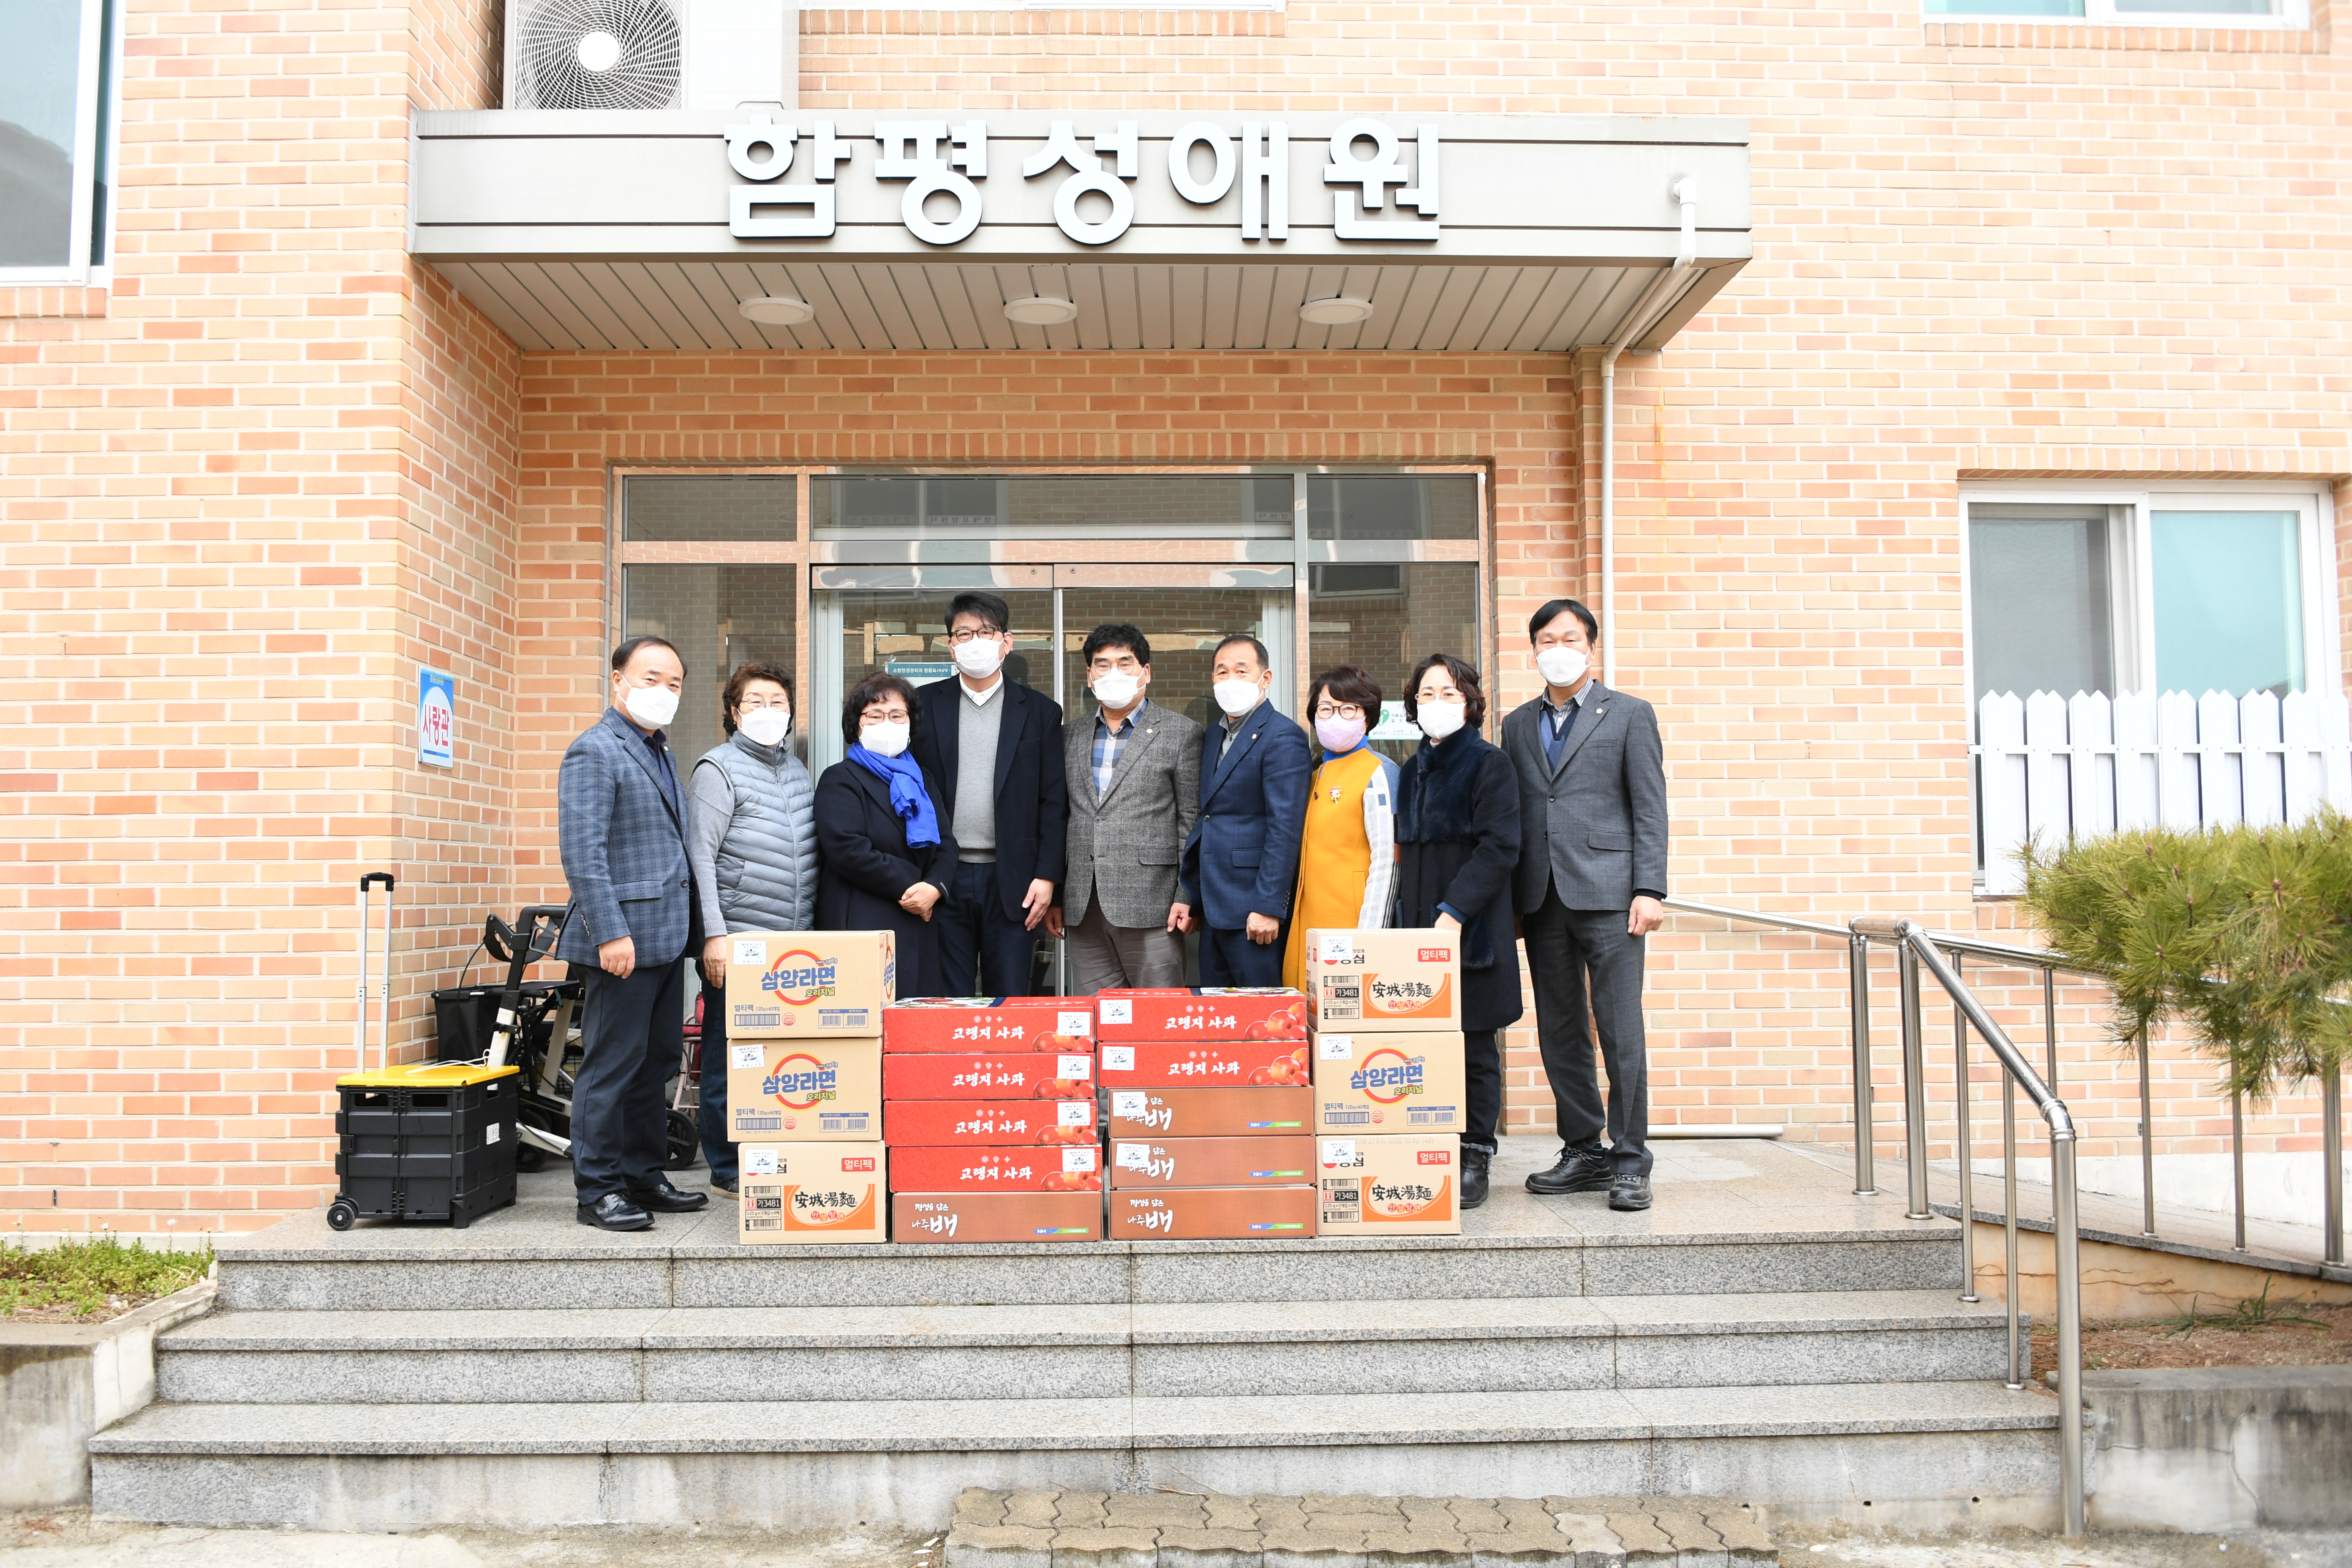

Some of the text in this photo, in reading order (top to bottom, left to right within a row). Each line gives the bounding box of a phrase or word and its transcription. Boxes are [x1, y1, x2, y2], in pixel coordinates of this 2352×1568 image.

[724, 113, 1440, 246] 함평성애원
[423, 704, 449, 747] 사랑관
[1421, 950, 1448, 960] 멀티팩
[761, 966, 835, 991] 삼양라면
[805, 986, 835, 997] 오리지널
[1336, 989, 1358, 997] 가3481
[1388, 1000, 1422, 1010] 안성탕면
[1165, 1015, 1237, 1029] 고랭지 사과
[952, 1025, 1025, 1040] 고랭지 사과
[1168, 1061, 1240, 1075] 고랭지 사과
[762, 1070, 836, 1094] 삼양라면
[952, 1072, 1025, 1087] 고랭지 사과
[1350, 1064, 1423, 1089] 삼양라면
[806, 1090, 836, 1101] 오리지널
[1394, 1084, 1423, 1096] 오리지널
[954, 1119, 1027, 1134] 고랭지 사과
[1420, 1153, 1447, 1163] 멀티팩
[844, 1159, 872, 1170] 멀티팩
[960, 1166, 1033, 1181] 고랭지 사과
[1335, 1192, 1357, 1200] 가3481
[757, 1199, 780, 1208] 가3481
[915, 1202, 949, 1211] 정성을 담은
[1130, 1198, 1164, 1207] 정성을 담은
[1388, 1203, 1421, 1213] 안성탕면
[811, 1211, 845, 1222] 안성탕면
